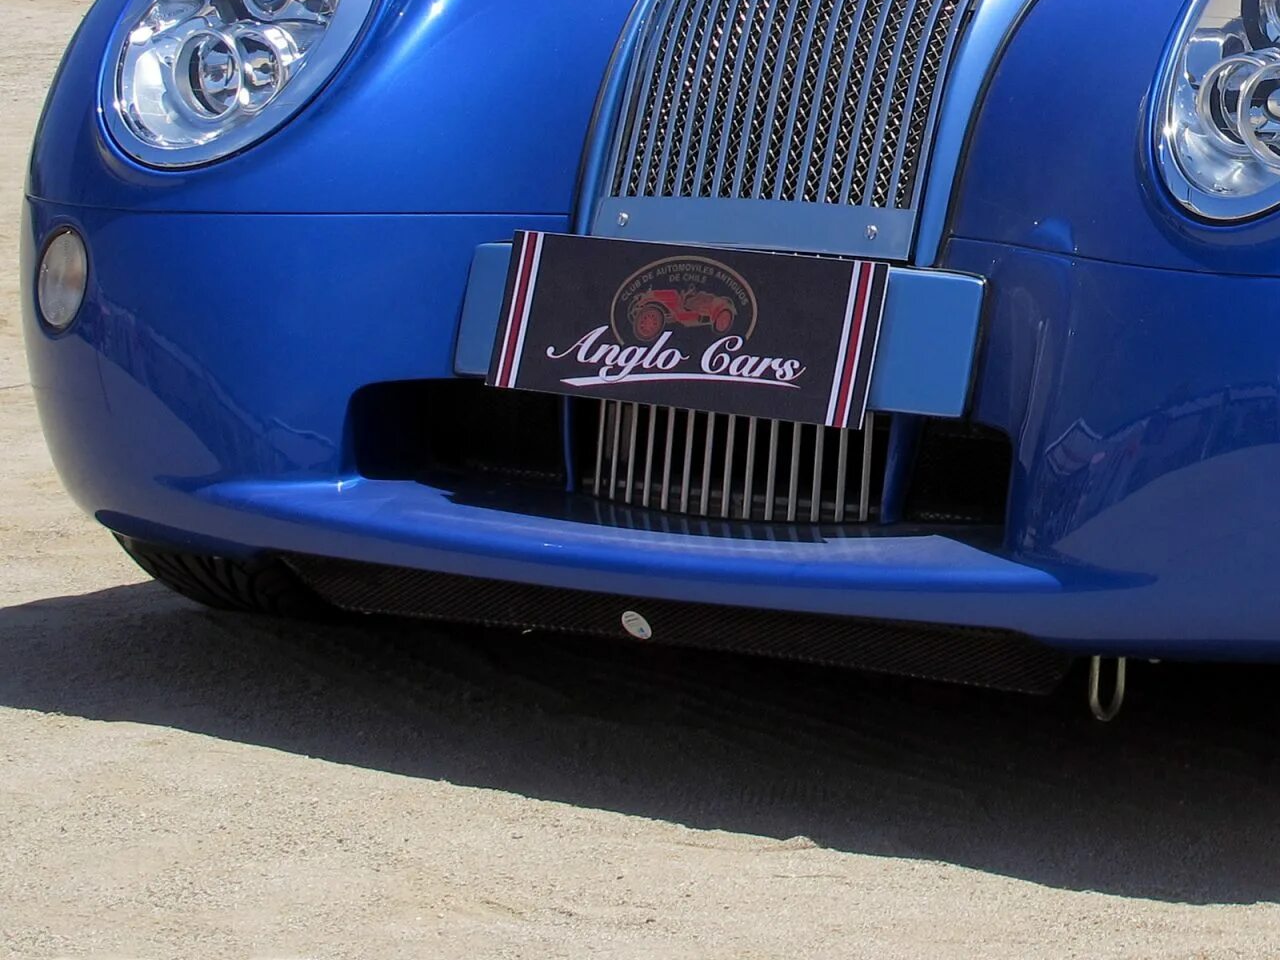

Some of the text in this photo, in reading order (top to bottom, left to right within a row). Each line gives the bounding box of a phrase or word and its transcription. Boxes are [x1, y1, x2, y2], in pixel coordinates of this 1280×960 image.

[621, 279, 641, 301] CLUB
[641, 271, 655, 284] DE
[714, 271, 750, 306] ANTIGUOS
[668, 272, 708, 284] DE CHILE
[546, 325, 807, 384] Anglo Cars
